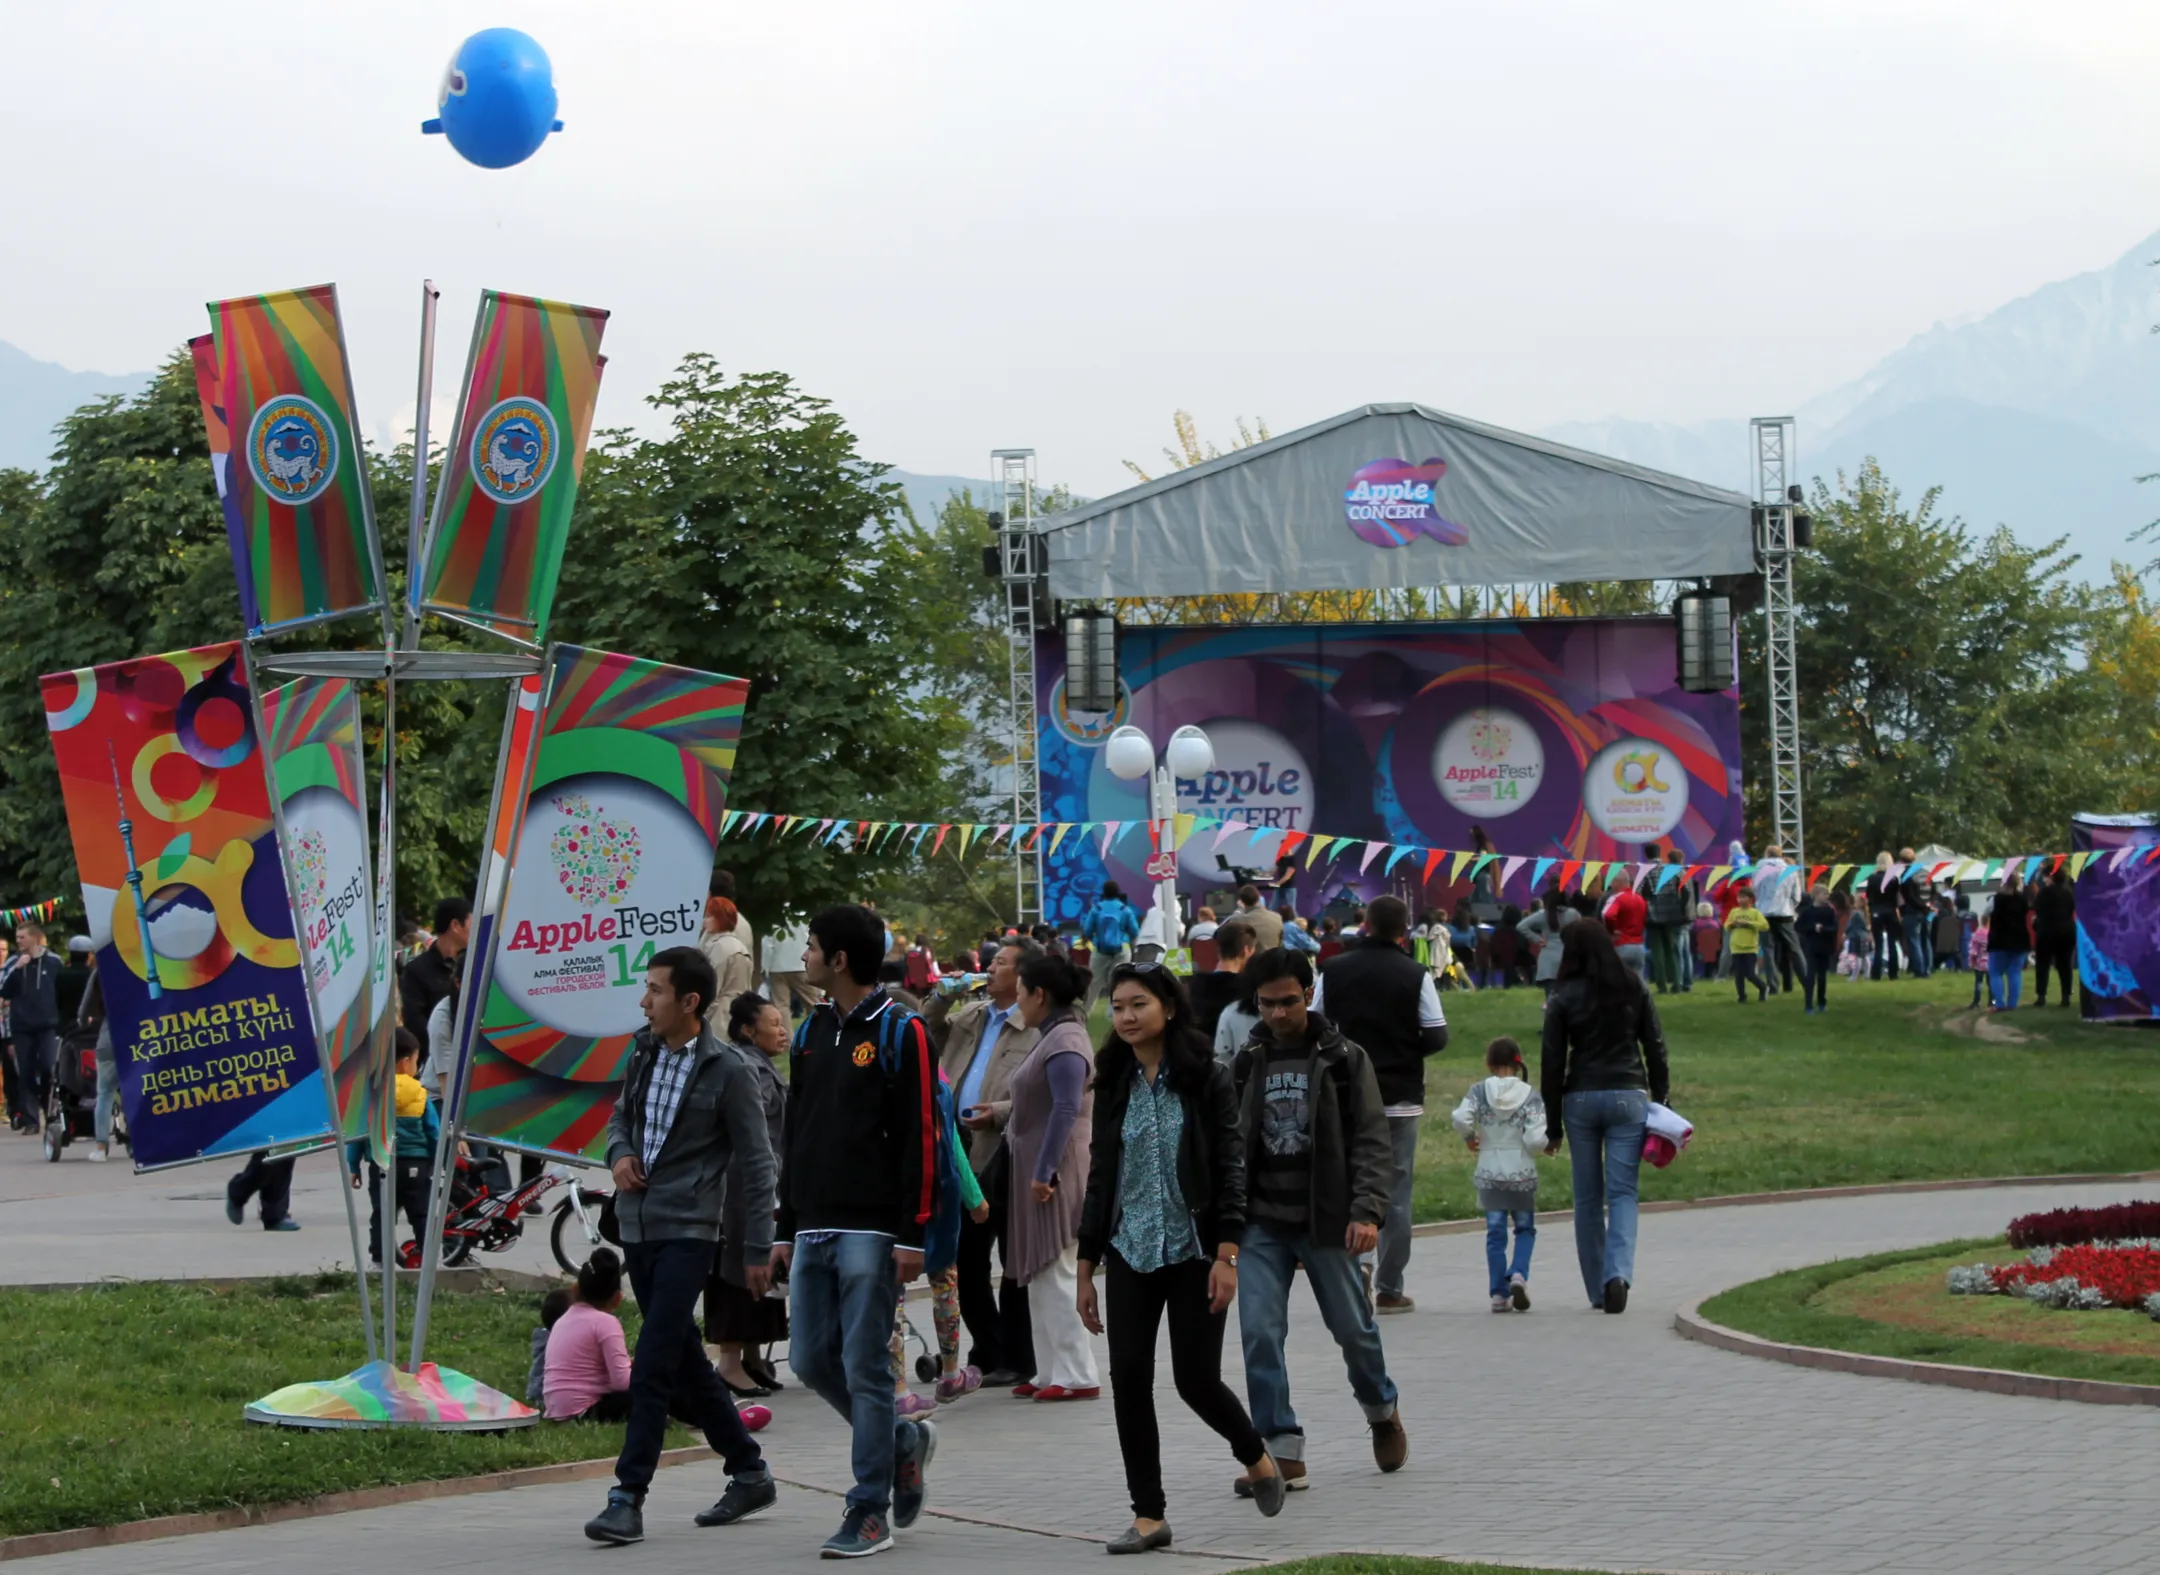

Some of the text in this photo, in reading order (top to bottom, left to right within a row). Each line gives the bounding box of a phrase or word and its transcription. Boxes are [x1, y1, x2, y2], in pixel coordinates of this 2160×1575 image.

[1348, 479, 1429, 505] Apple
[1348, 504, 1430, 520] CONCERT
[1493, 780, 1518, 800] 14
[307, 866, 363, 951] leFest'
[506, 900, 701, 955] AppleFest'
[325, 920, 355, 977] 14
[608, 940, 656, 988] 14
[527, 981, 606, 996] ФЕСТИВАЛЬ ЯБЛОК
[534, 969, 557, 979] АЛМА
[129, 1007, 296, 1063] қаласы күні
[138, 993, 281, 1041] алматы
[141, 1044, 297, 1096] день города
[151, 1069, 291, 1116] алматы
[517, 1177, 553, 1208] DREGO
